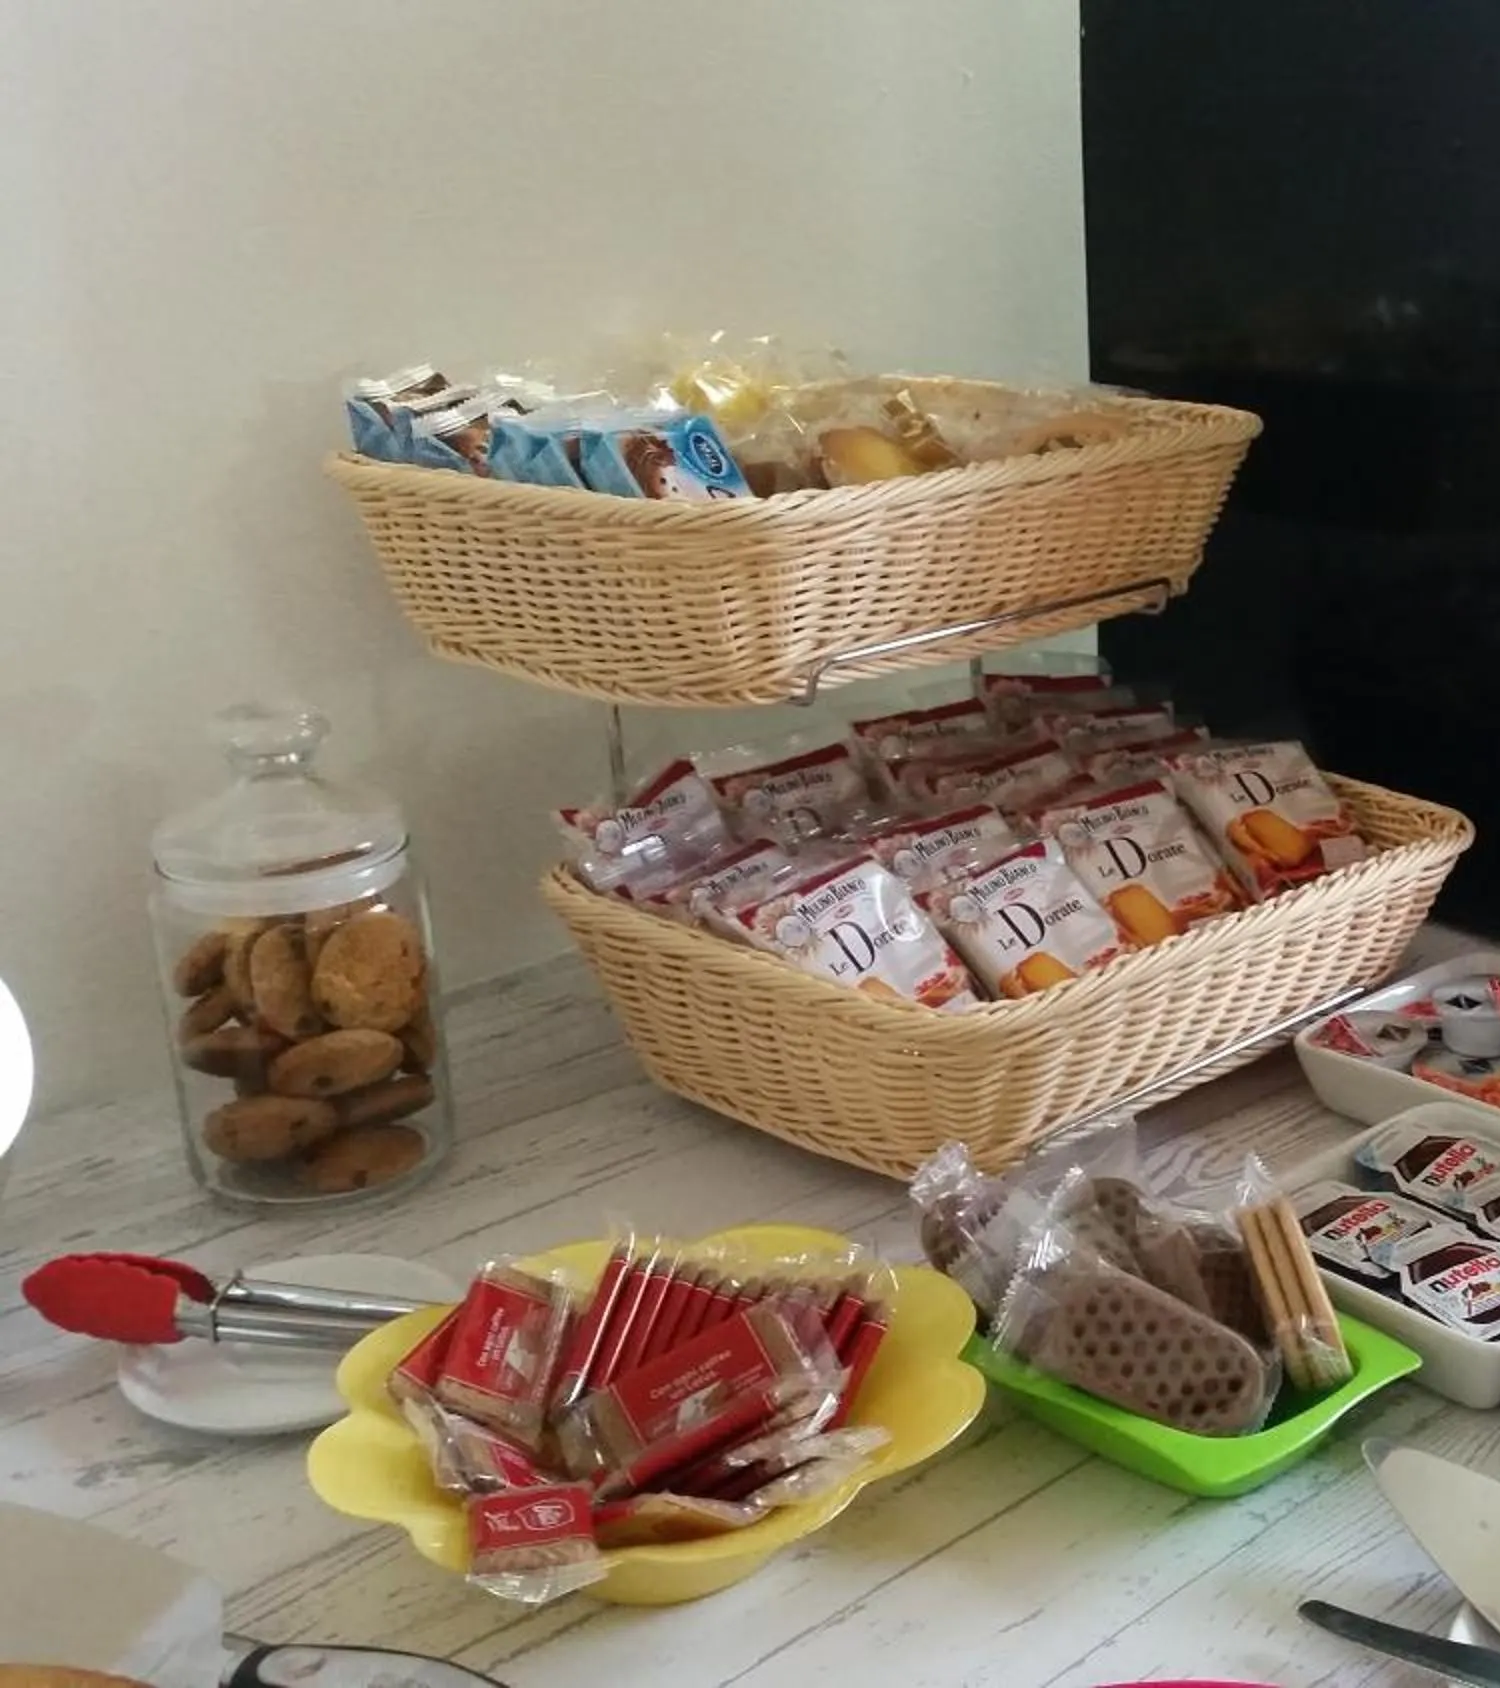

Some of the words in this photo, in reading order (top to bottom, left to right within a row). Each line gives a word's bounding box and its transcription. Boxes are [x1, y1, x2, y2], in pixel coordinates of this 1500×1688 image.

[1103, 835, 1187, 879] Dorate
[995, 897, 1084, 950] Dorate
[997, 935, 1017, 951] Le
[829, 957, 849, 977] Le
[1422, 1140, 1478, 1188] nutella
[1322, 1199, 1391, 1241] nutella
